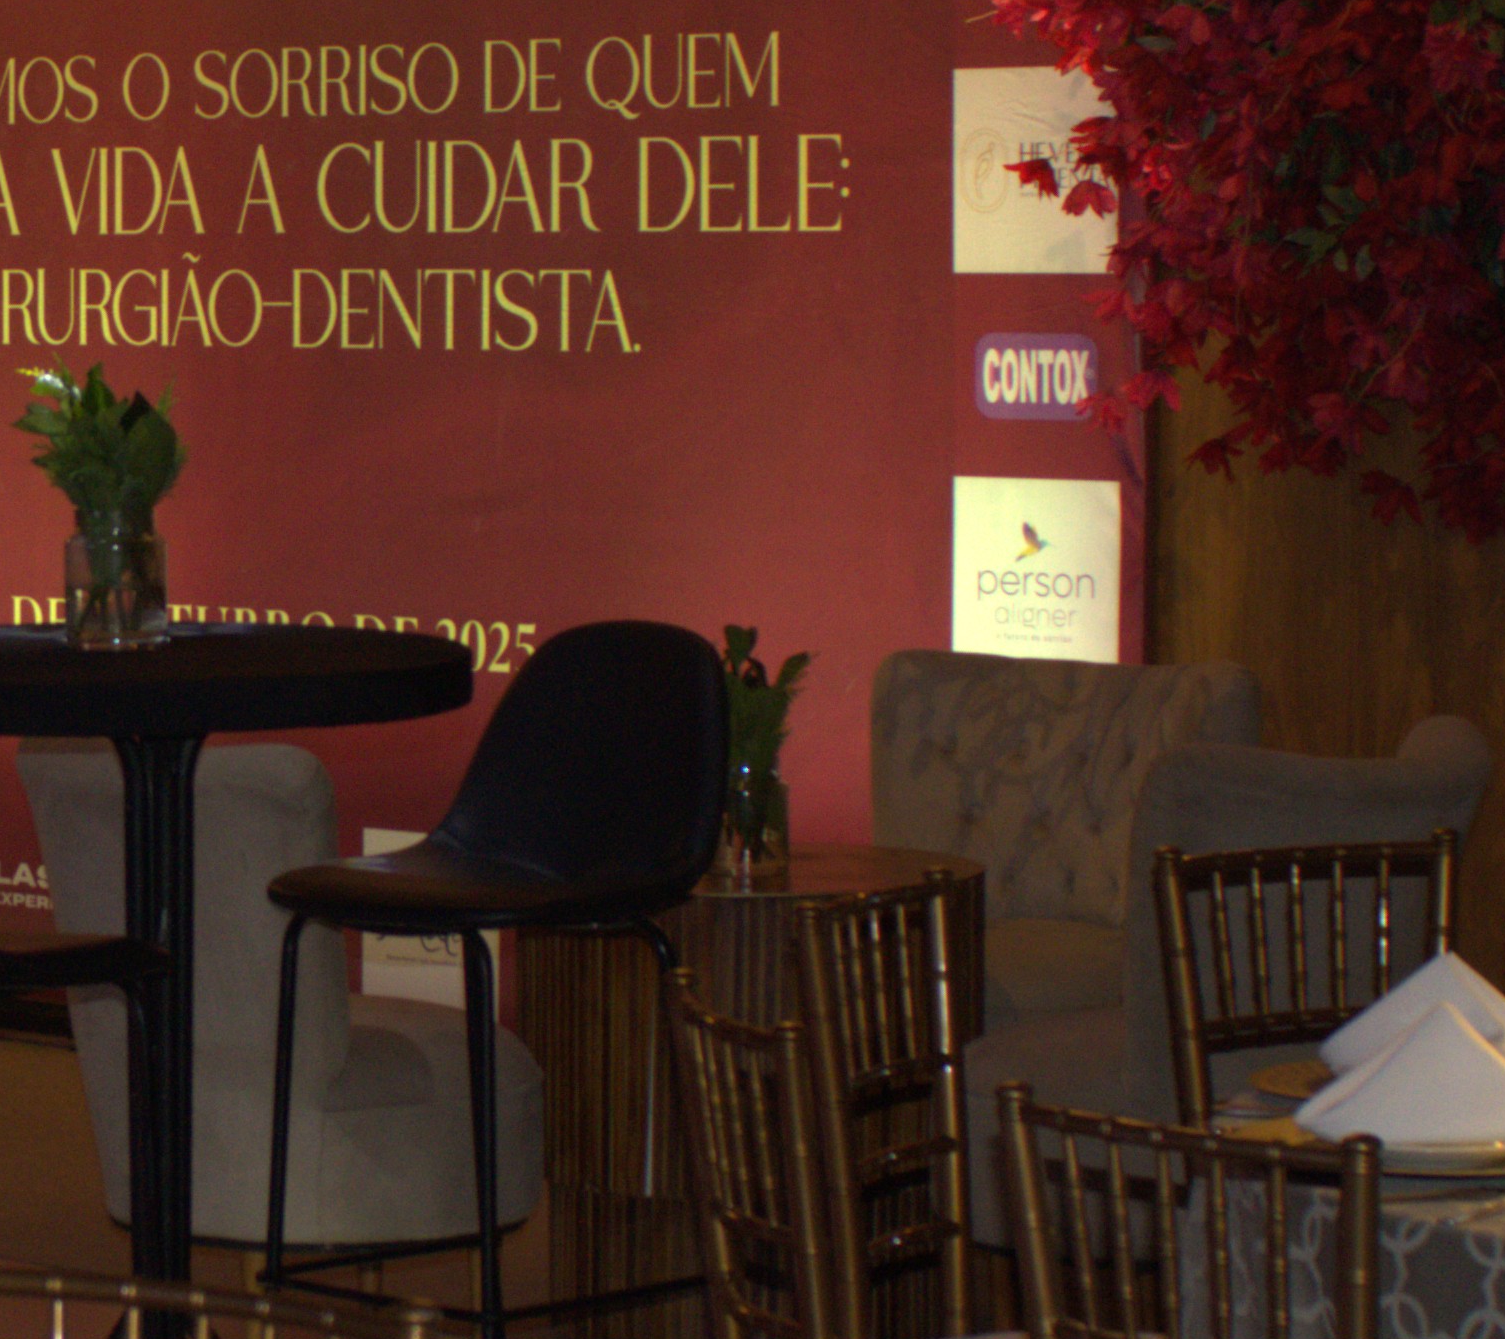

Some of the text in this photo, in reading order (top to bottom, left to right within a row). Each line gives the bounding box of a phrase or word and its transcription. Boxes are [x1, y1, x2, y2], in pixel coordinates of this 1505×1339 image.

[122, 52, 170, 122] O
[194, 42, 460, 120] SORRISO
[484, 37, 562, 113] DE
[585, 30, 780, 120] QUEM
[51, 145, 205, 236] VIDA
[237, 144, 286, 234] A
[317, 137, 601, 234] CUIDAR
[638, 134, 851, 232] DELE:
[983, 348, 1089, 405] CONTOX
[977, 569, 1095, 600] person
[994, 605, 1077, 629] aligner
